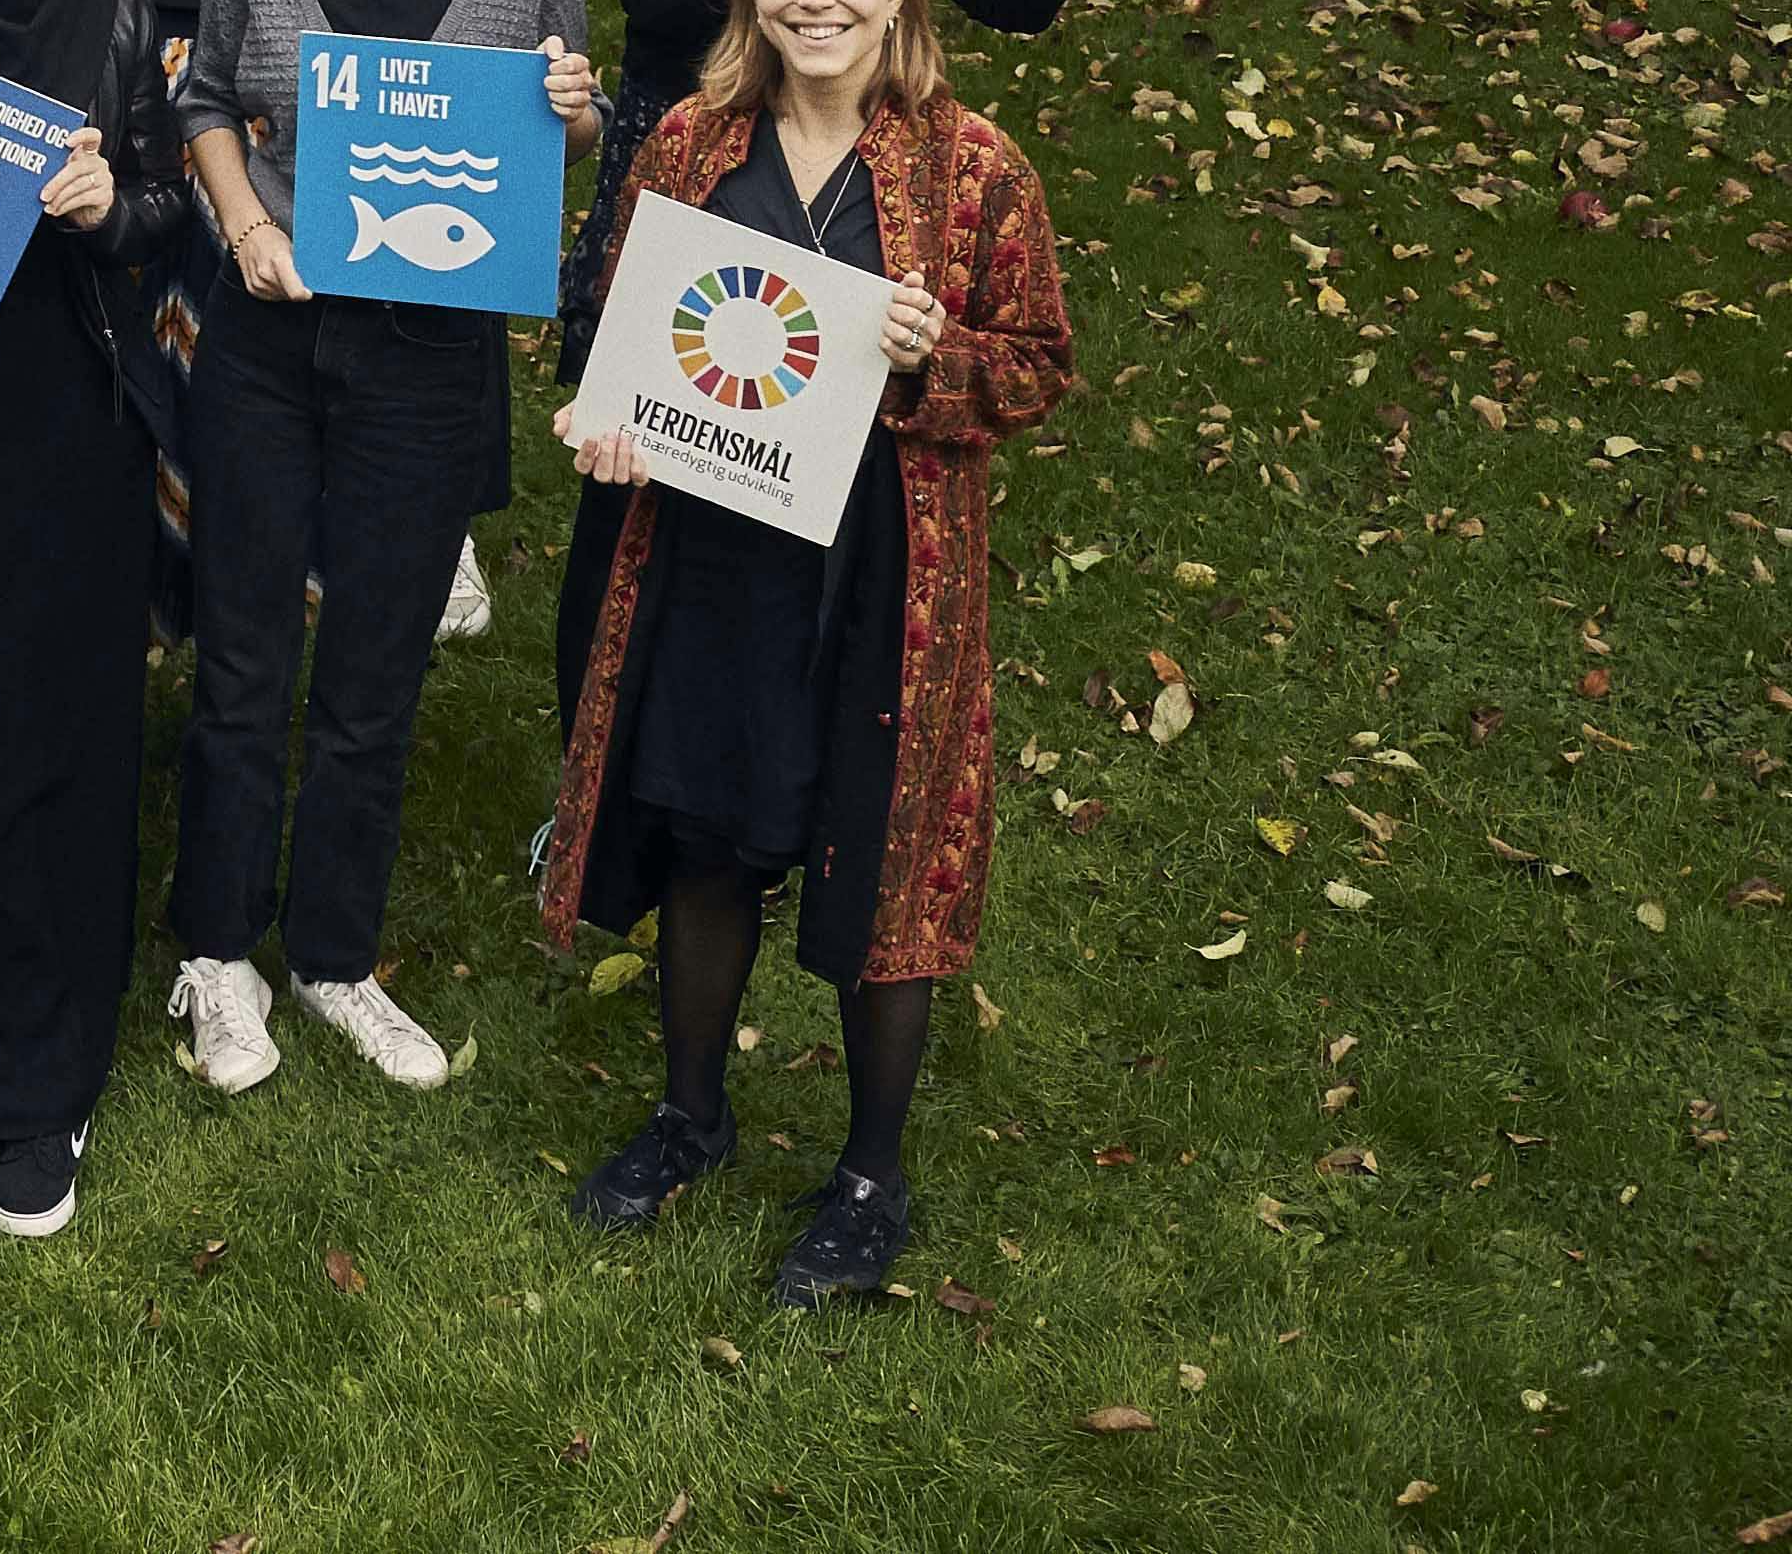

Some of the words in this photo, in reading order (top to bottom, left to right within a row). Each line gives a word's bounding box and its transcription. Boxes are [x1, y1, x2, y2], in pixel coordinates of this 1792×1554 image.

[311, 52, 360, 111] 14
[380, 57, 432, 86] LIVET
[378, 90, 385, 114] I
[389, 93, 452, 120] HAVET
[44, 124, 69, 149] OG
[633, 394, 793, 483] VERDENSMÅL
[641, 434, 727, 482] bæredygtig
[727, 471, 795, 508] udvikling
